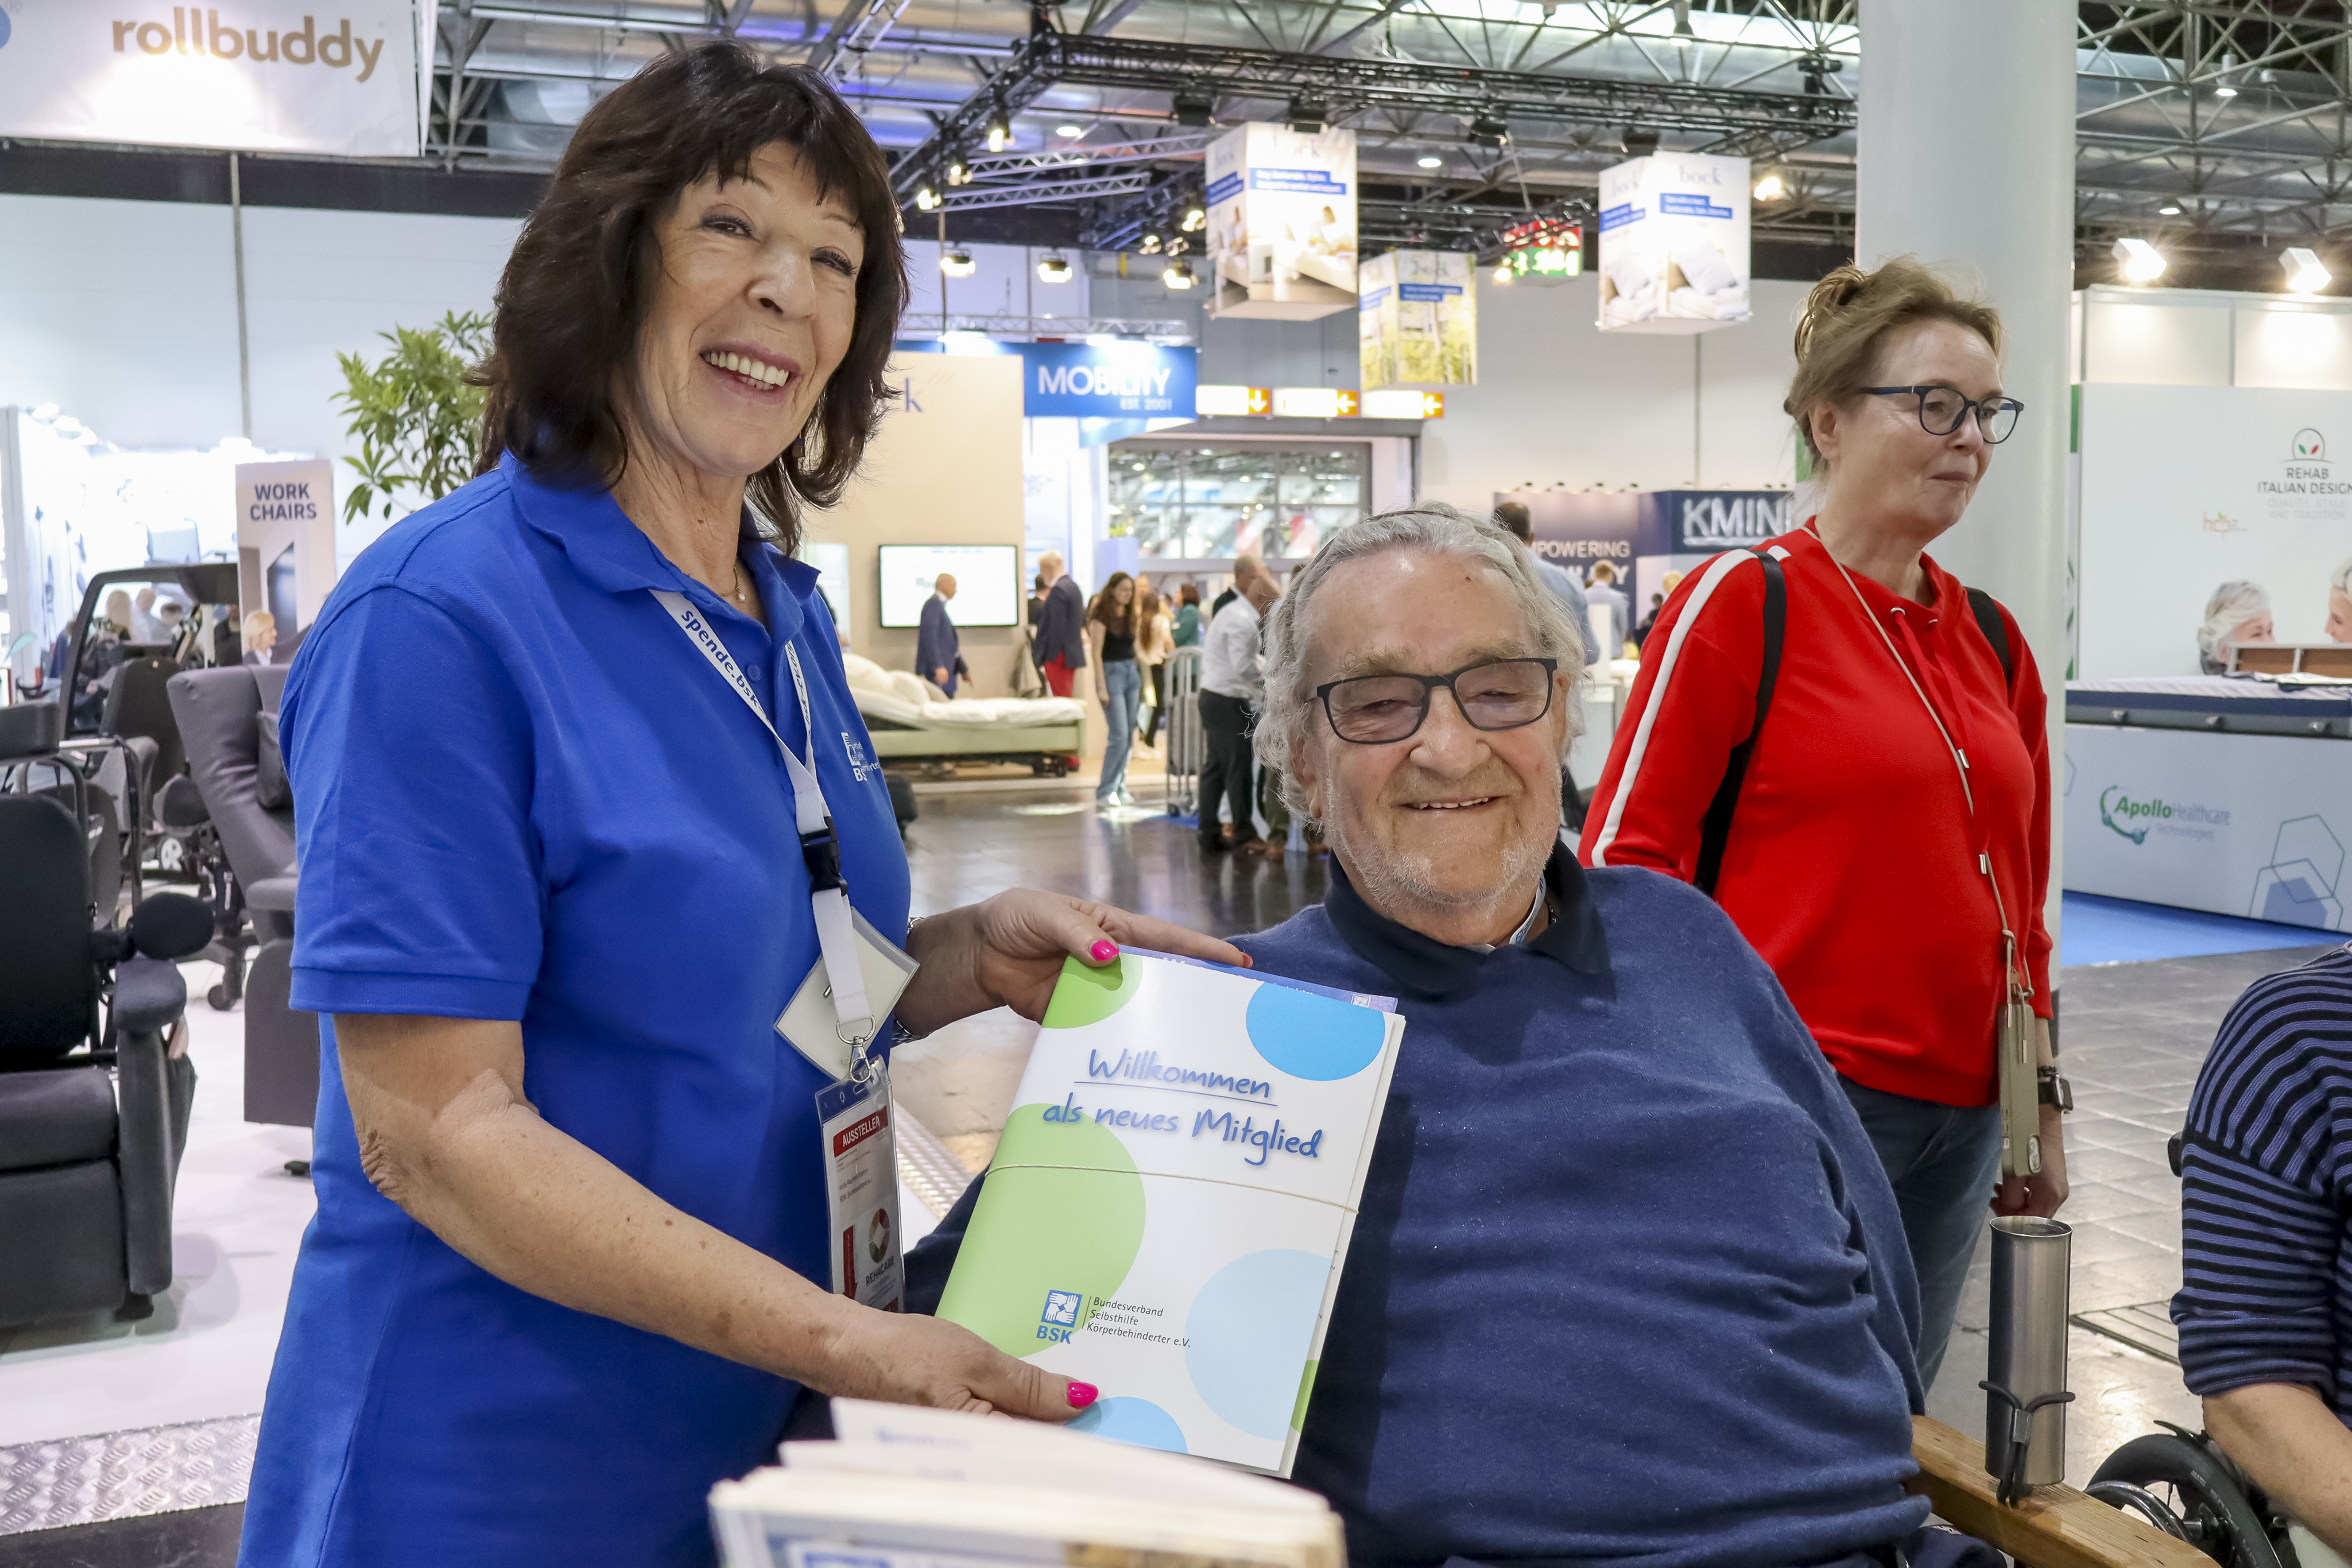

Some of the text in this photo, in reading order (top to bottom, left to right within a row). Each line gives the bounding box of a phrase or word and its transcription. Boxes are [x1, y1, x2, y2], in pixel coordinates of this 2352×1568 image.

[113, 6, 384, 83] rollbuddy
[1679, 165, 1722, 186] bock
[1038, 365, 1170, 396] MOBILITY
[1144, 398, 1173, 410] 2001
[2287, 468, 2329, 479] REHAB
[255, 483, 310, 501] WORK
[2258, 482, 2306, 493] ITALIAN
[250, 503, 317, 521] CHAIRS
[1089, 1049, 1271, 1099] Willkommen
[843, 1115, 880, 1147] AUSSTELLER
[1042, 1092, 1323, 1166] als neues Mitglied
[866, 1255, 895, 1286] REHACARE
[1093, 1297, 1163, 1316] Bundesverband
[1090, 1309, 1139, 1325] Selbsthilfe
[1036, 1325, 1073, 1344] BSK
[1087, 1322, 1191, 1347] Körperbehinderter e.V.
